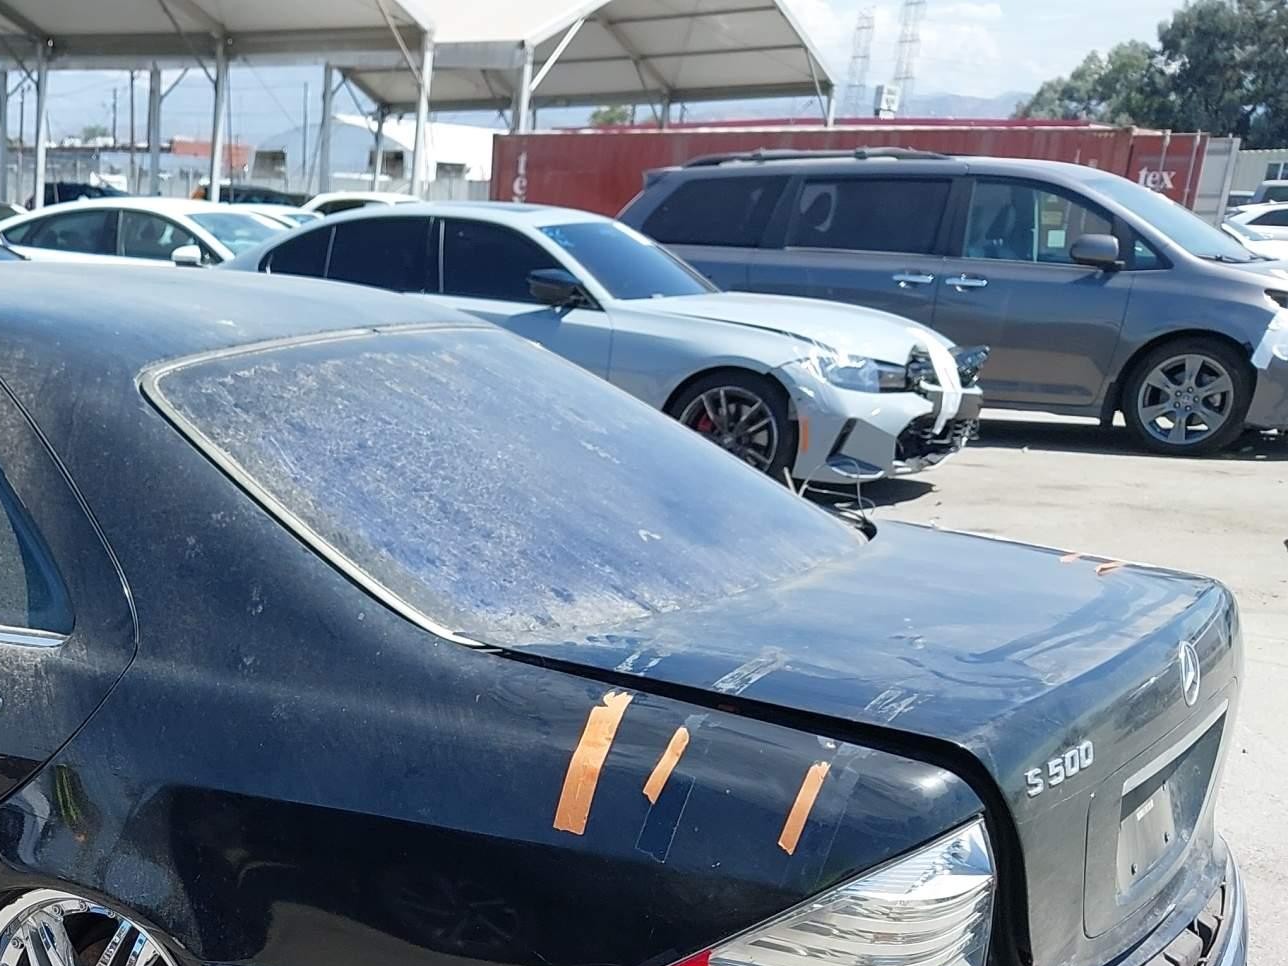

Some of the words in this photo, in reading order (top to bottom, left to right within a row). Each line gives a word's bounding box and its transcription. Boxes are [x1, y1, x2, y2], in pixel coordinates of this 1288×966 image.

[1138, 166, 1176, 190] tex
[1024, 767, 1044, 798] S
[1048, 740, 1094, 787] 500
